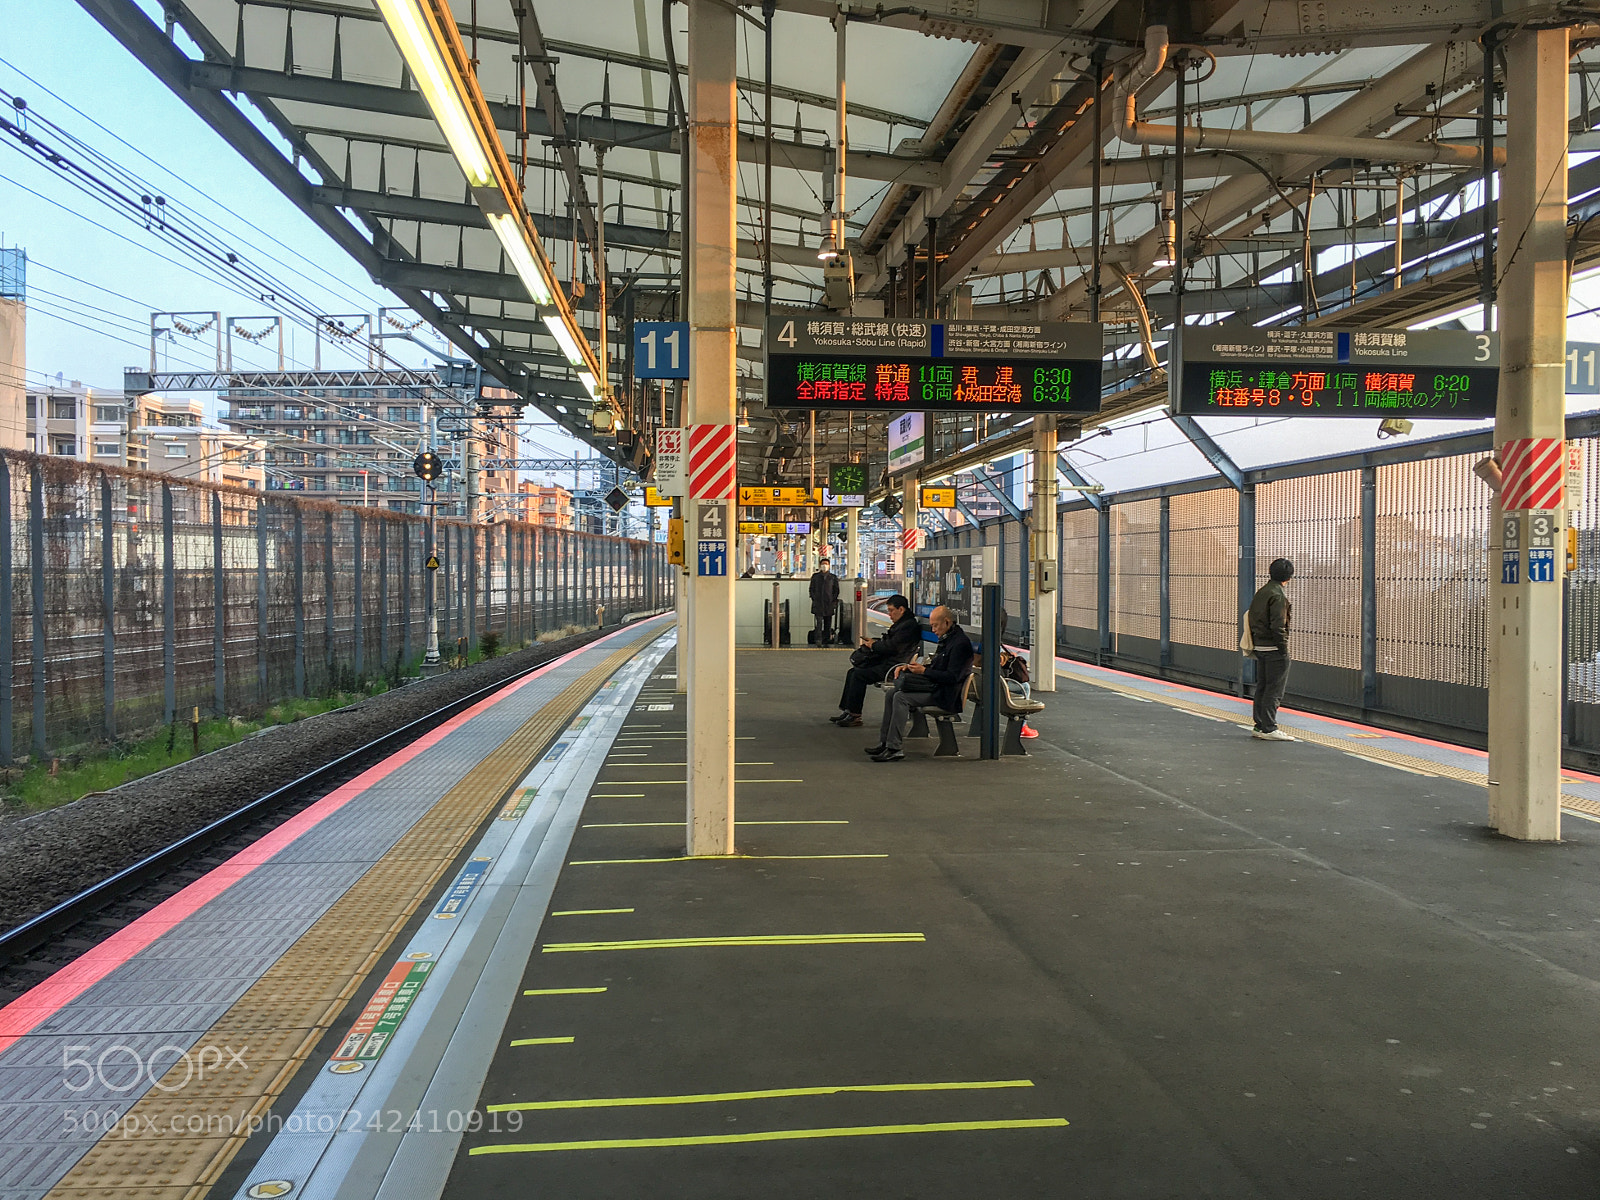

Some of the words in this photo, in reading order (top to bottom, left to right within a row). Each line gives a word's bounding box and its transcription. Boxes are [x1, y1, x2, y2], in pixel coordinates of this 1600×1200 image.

[777, 320, 798, 348] 4
[879, 338, 896, 347] Line
[897, 338, 927, 348] (Rapid)
[1354, 332, 1407, 347] 横須賀線
[641, 330, 679, 369] 11
[1354, 347, 1390, 356] Yokosuka
[1391, 348, 1408, 356] Line
[1474, 334, 1491, 362] 3
[797, 362, 867, 381] 横須賀線
[875, 363, 911, 383] 普通
[918, 365, 954, 383] 11両
[1033, 367, 1072, 385] 6:30
[1566, 349, 1595, 386] 11
[1365, 372, 1415, 391] 横須賀
[1433, 374, 1470, 391] 6:20
[796, 380, 866, 400] 全席指定
[874, 382, 910, 401] 特急
[921, 383, 953, 400] 6両
[964, 384, 1022, 403] 成田空港
[1032, 385, 1072, 403] 6:34
[703, 507, 721, 526] 4
[918, 514, 930, 525] 12
[702, 528, 722, 537] 番線
[1506, 520, 1516, 538] 3
[1534, 518, 1549, 536] 3
[699, 543, 725, 552] 柱番号
[1533, 537, 1550, 546] 番線
[1530, 551, 1553, 559] 柱番号
[703, 555, 722, 575] 11
[1505, 564, 1517, 583] 11
[1533, 562, 1551, 581] 11
